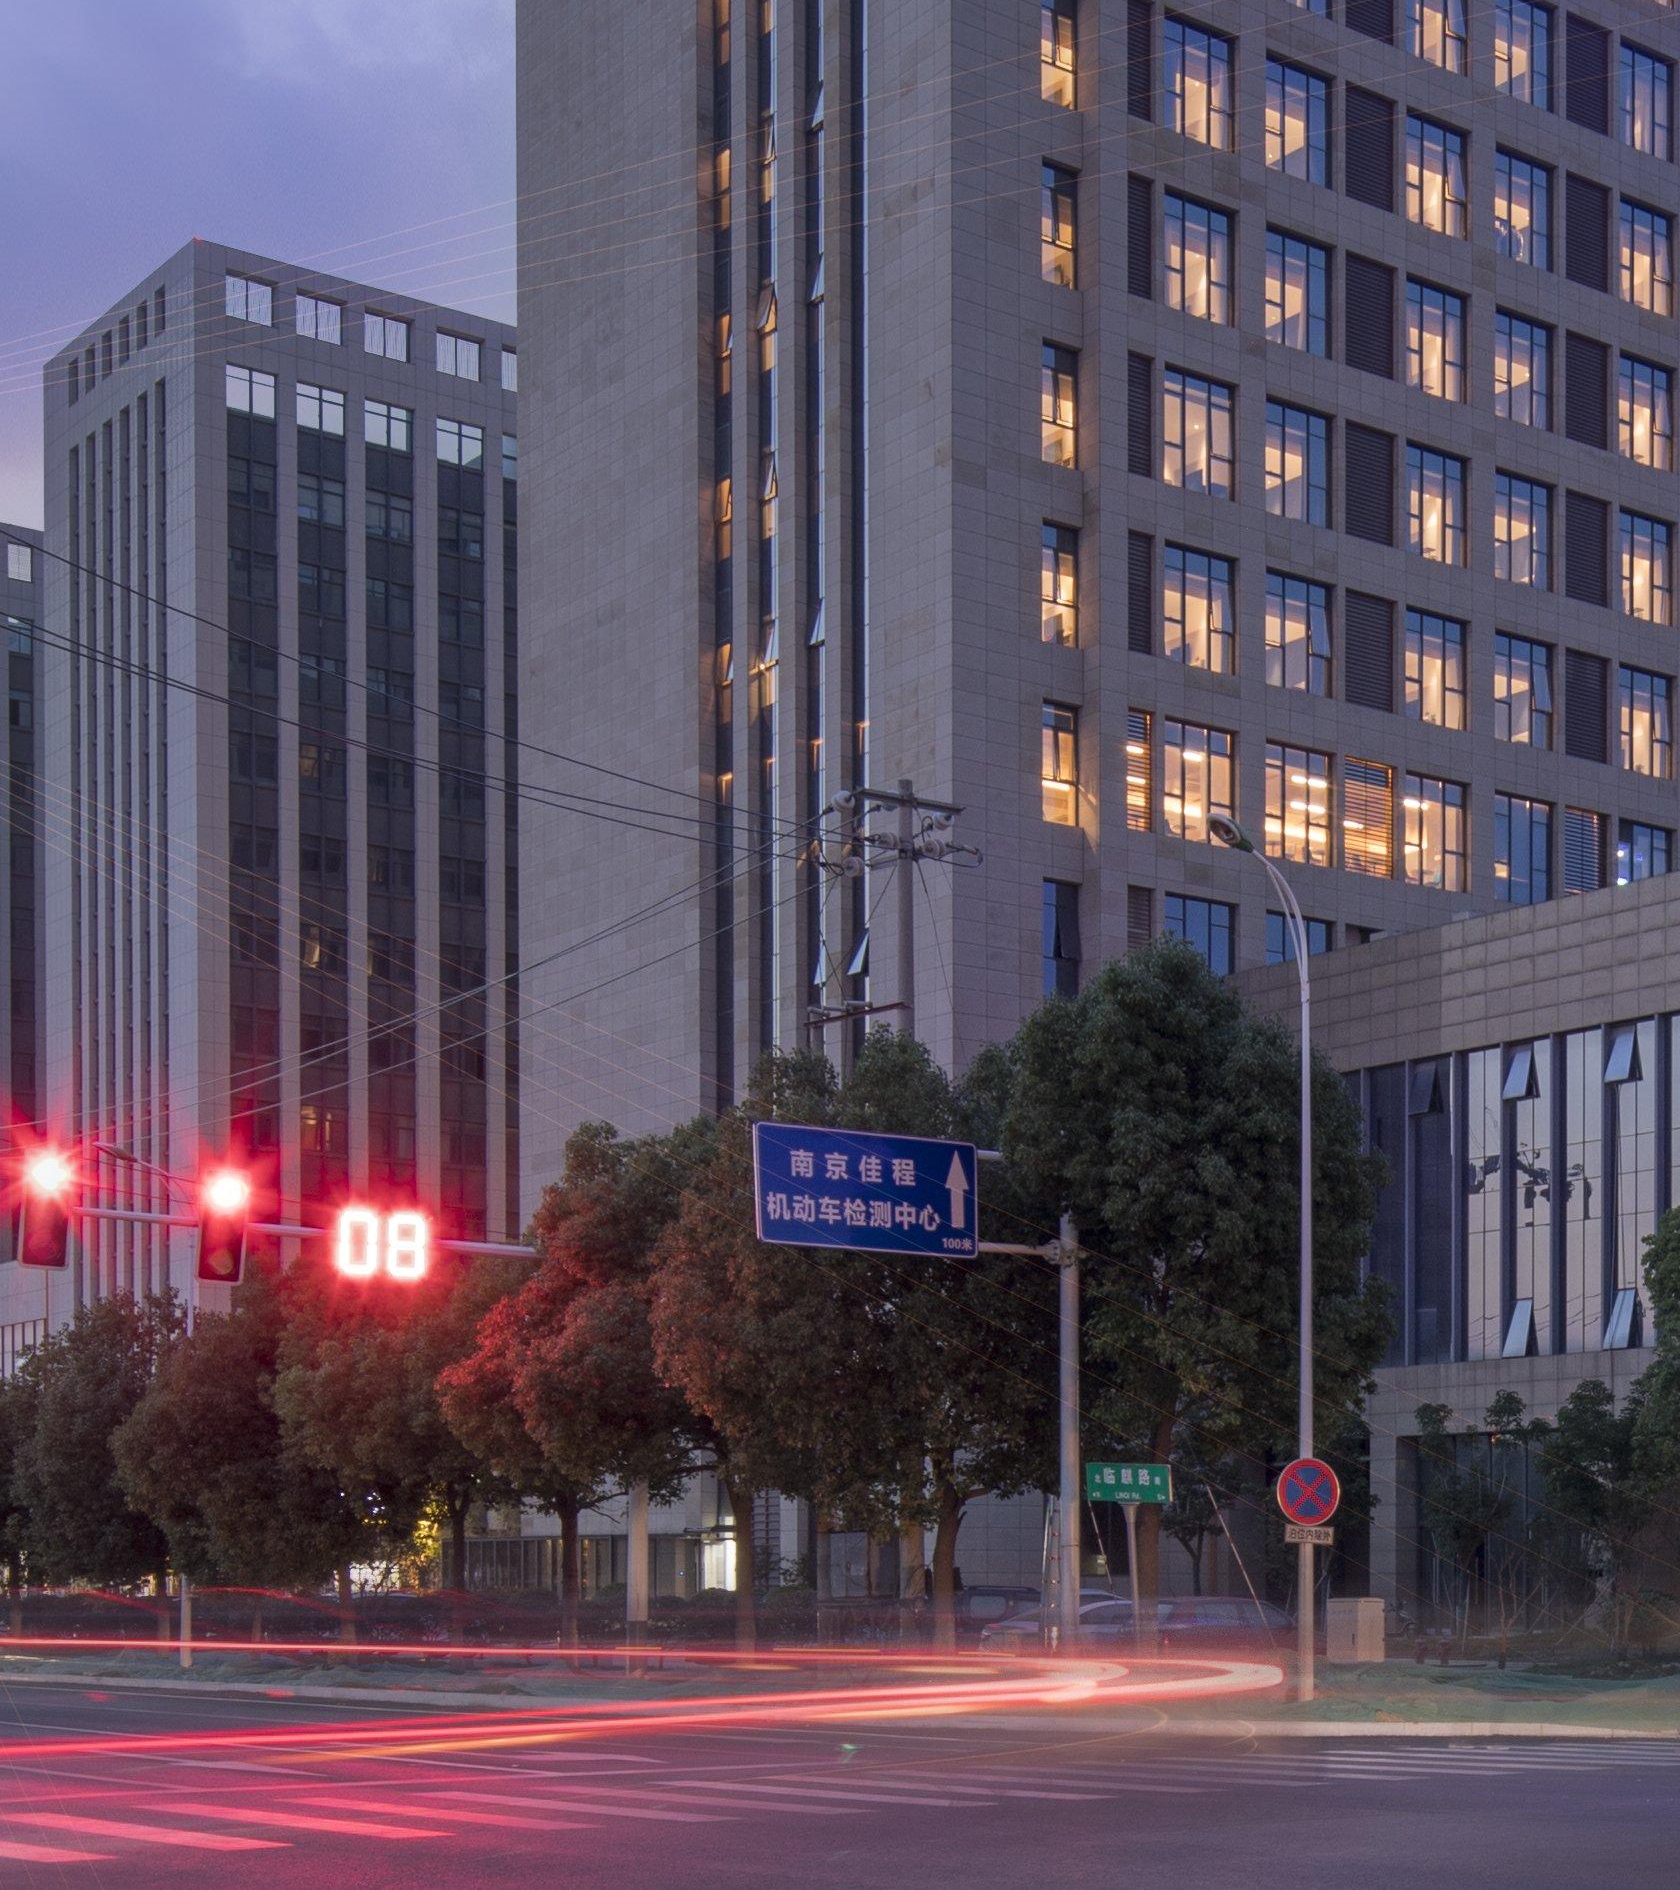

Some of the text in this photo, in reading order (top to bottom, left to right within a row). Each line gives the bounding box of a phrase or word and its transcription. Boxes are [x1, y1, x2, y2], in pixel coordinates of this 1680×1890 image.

[789, 1148, 917, 1187] 南京佳程
[766, 1191, 941, 1232] 机动车检测中心
[338, 1208, 427, 1279] 08
[941, 1236, 973, 1251] 100米
